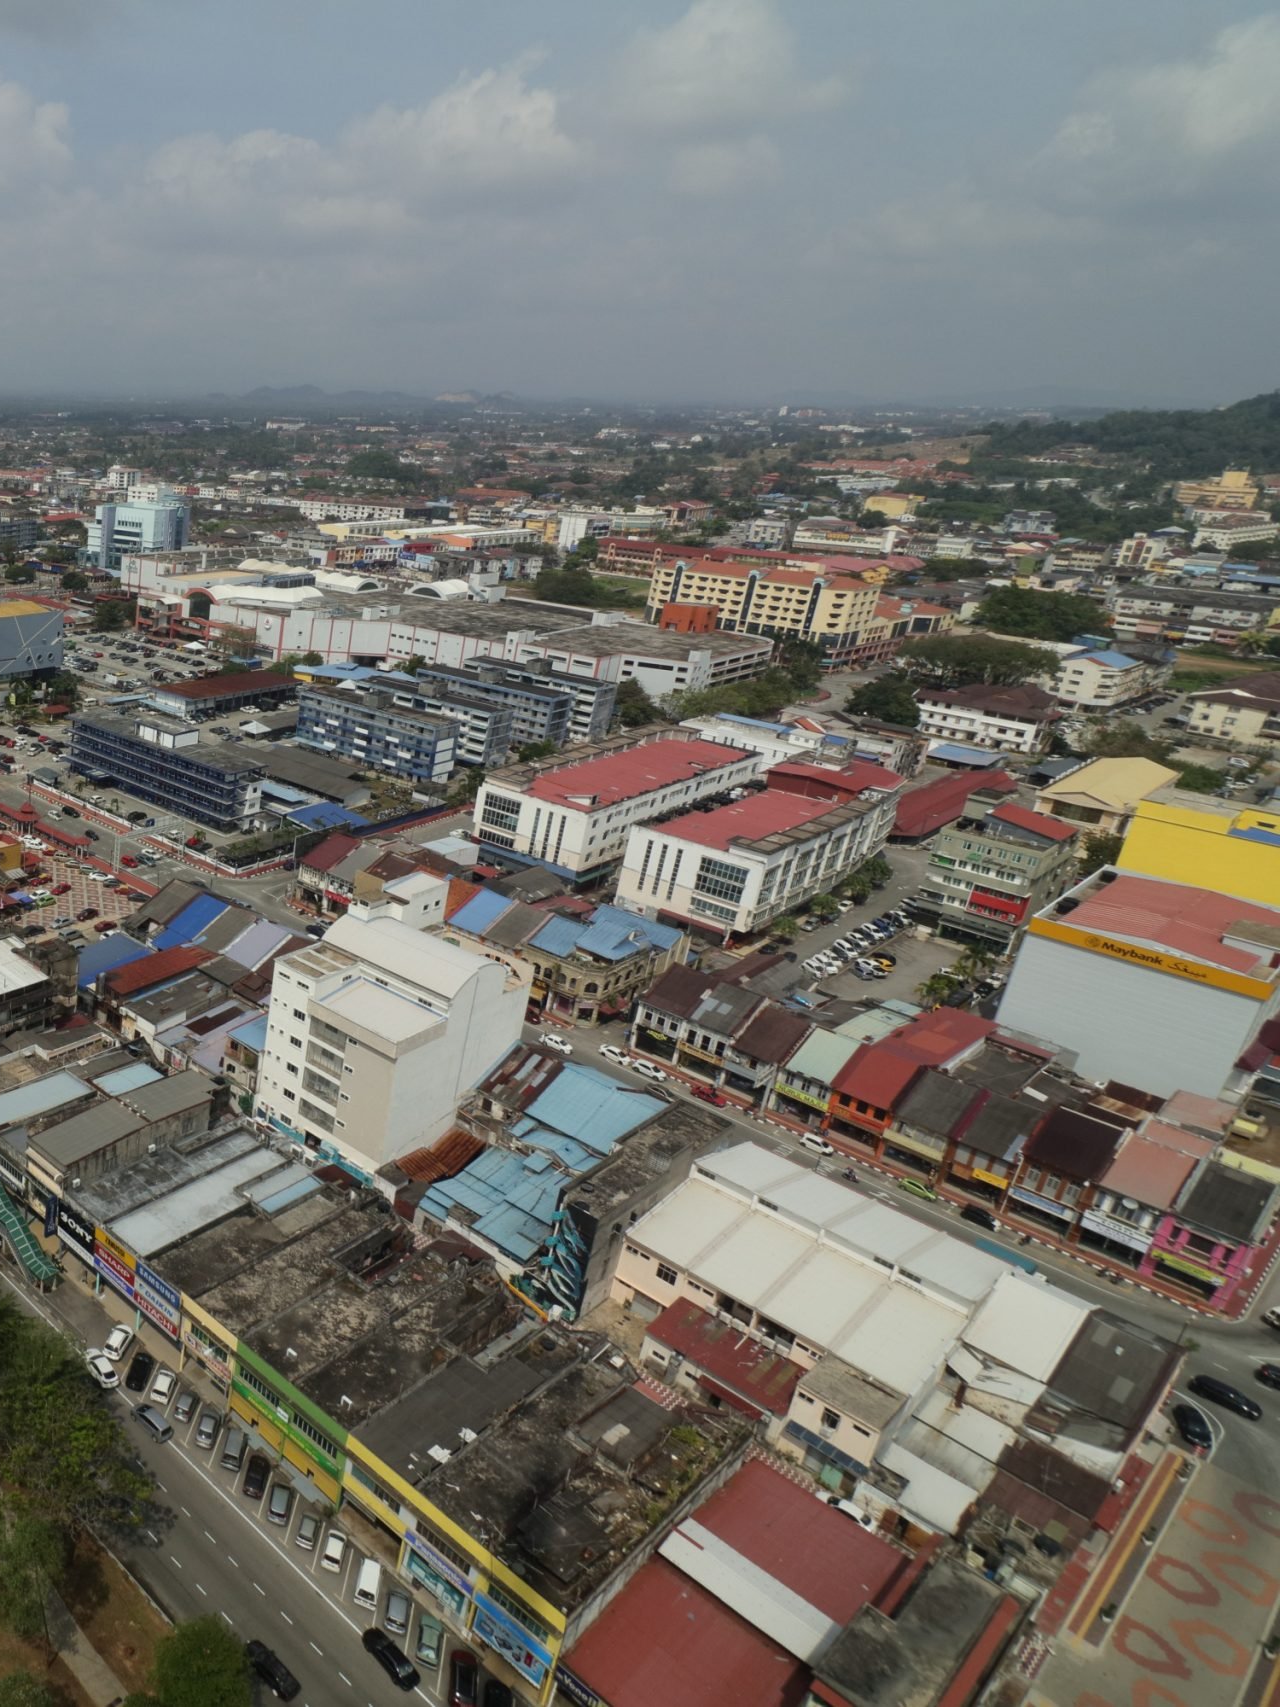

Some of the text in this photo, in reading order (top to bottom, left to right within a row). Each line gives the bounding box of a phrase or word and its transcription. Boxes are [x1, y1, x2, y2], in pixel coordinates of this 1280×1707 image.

[1101, 941, 1164, 966] Maybank
[60, 1211, 93, 1243] SONY
[99, 1248, 130, 1278] SHARP
[139, 1266, 176, 1303] SAMSUNG
[137, 1294, 173, 1331] HITACHI
[144, 1290, 173, 1317] DAIKIN
[415, 1539, 463, 1585] Panasonic
